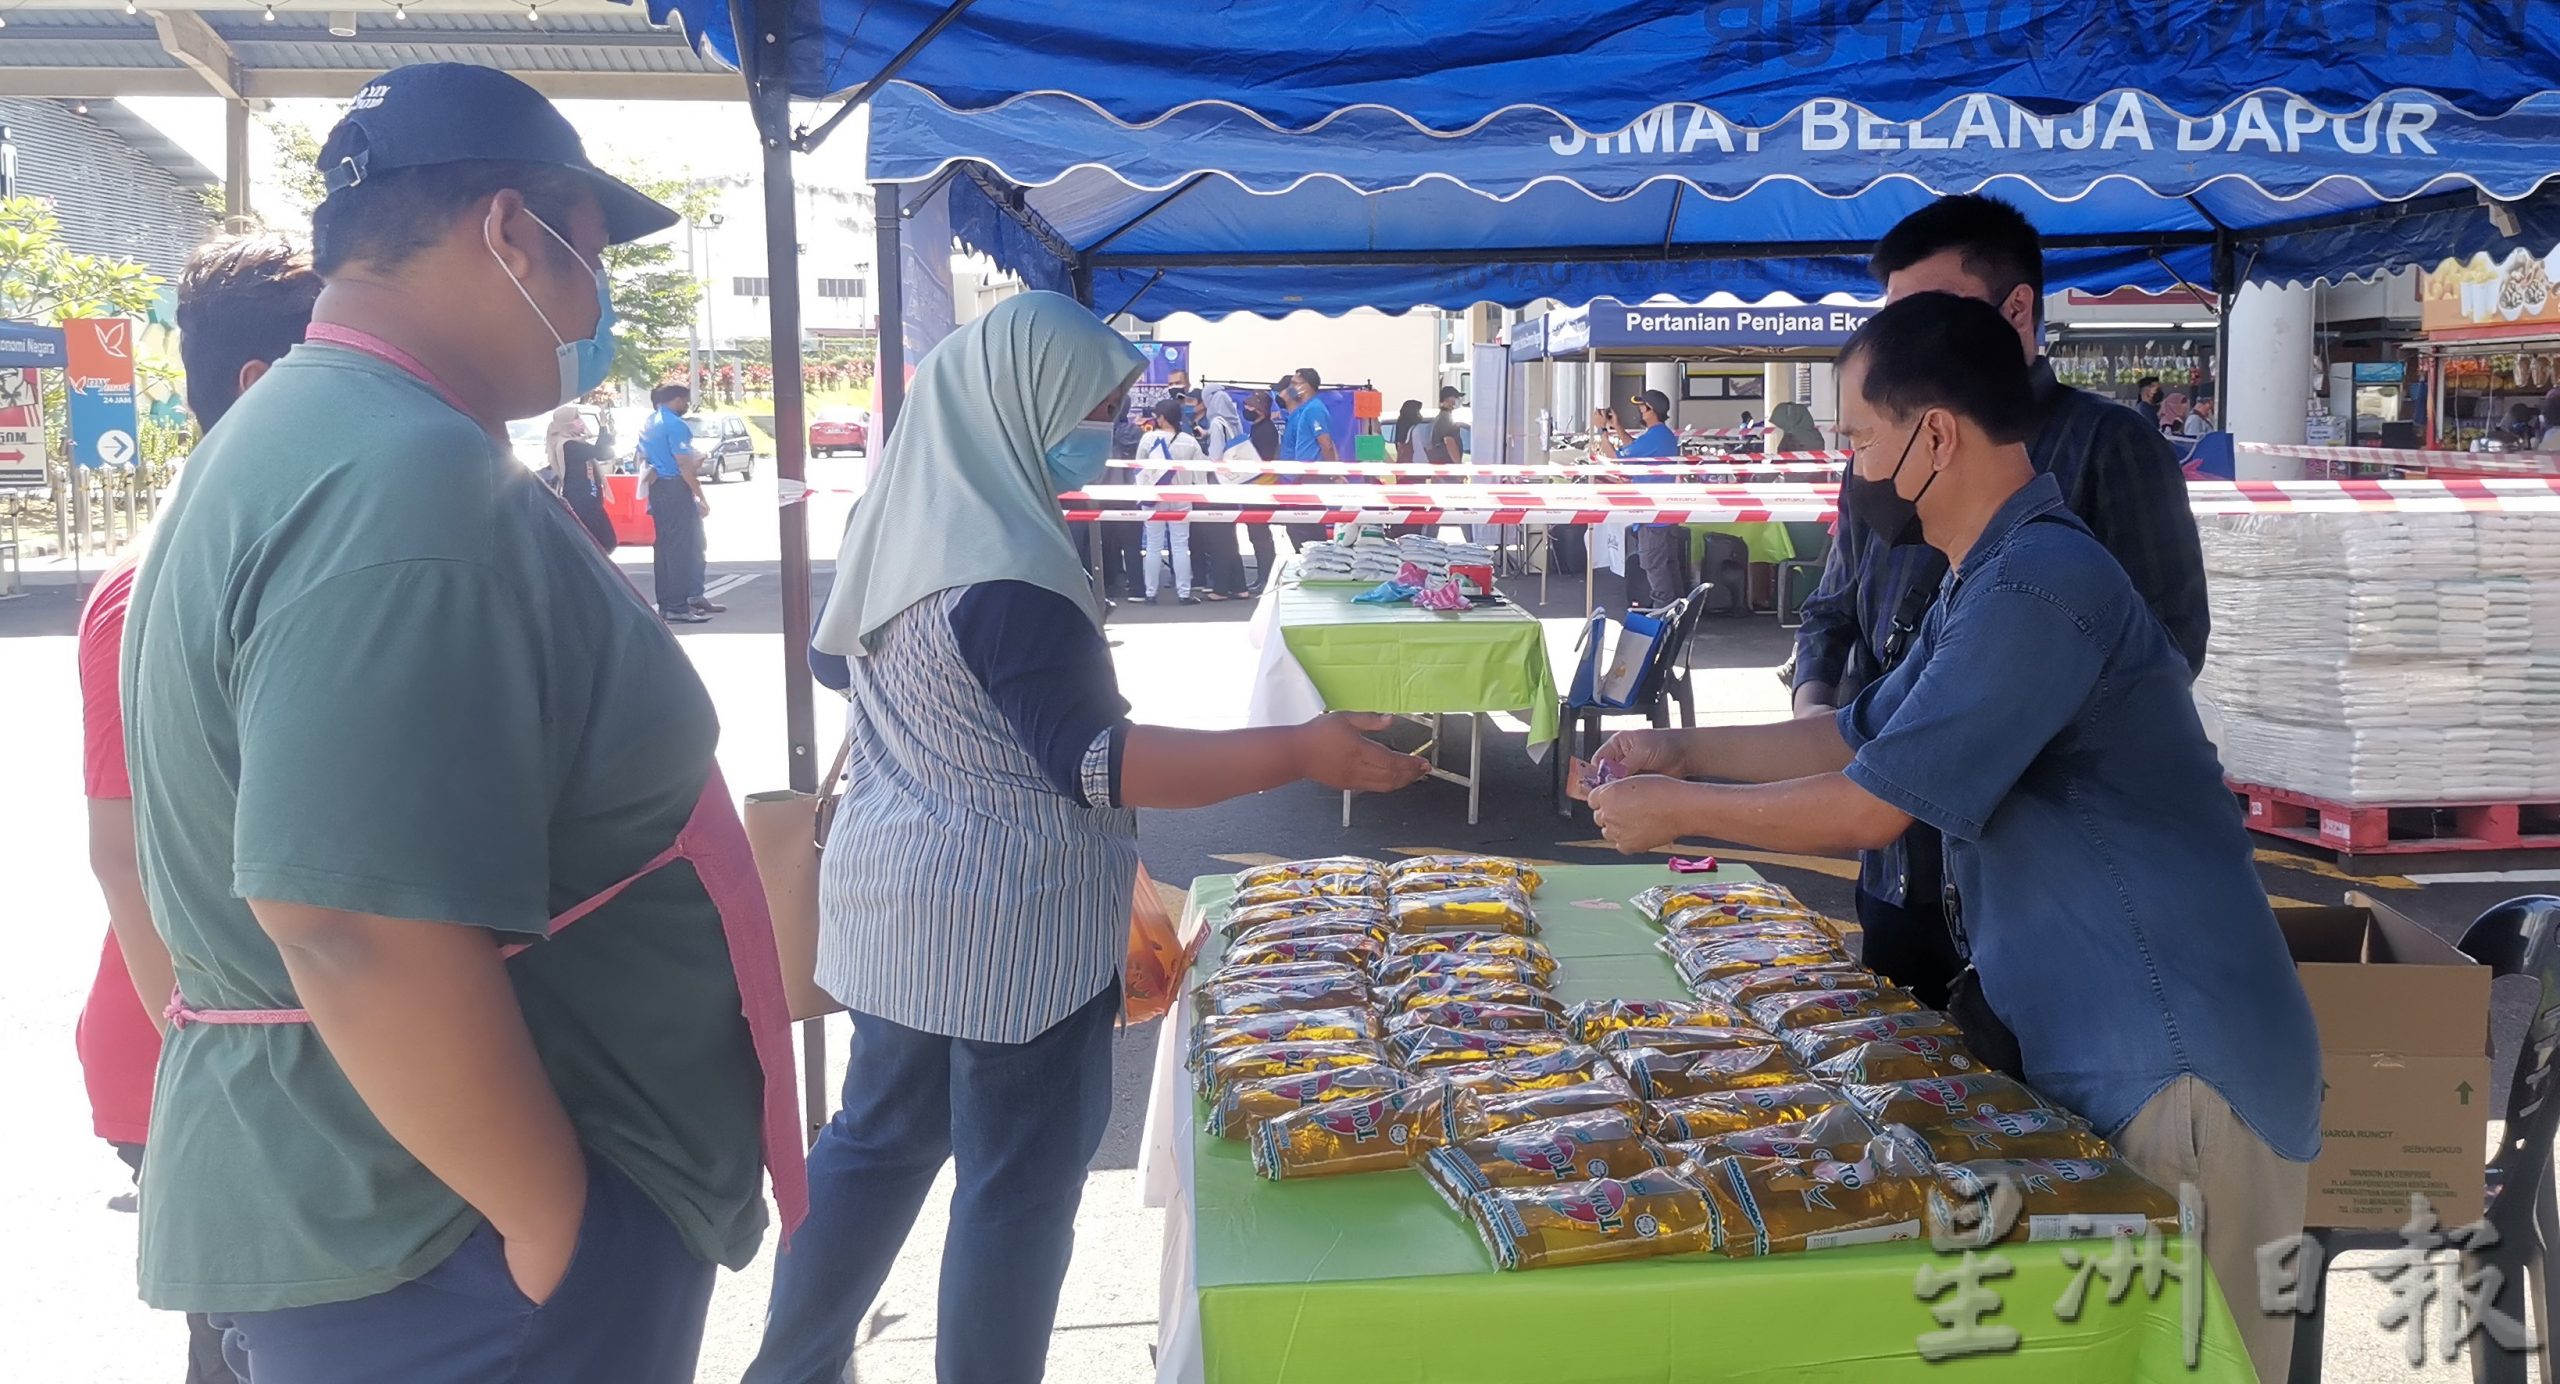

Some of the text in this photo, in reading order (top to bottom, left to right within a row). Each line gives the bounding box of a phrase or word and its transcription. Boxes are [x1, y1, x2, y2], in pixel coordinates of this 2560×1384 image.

[1549, 92, 2437, 156] JMA BELANJA DAPUR
[1626, 312, 1730, 332] Pertanian
[1737, 312, 1824, 335] Penjana
[27, 338, 56, 358] Negara
